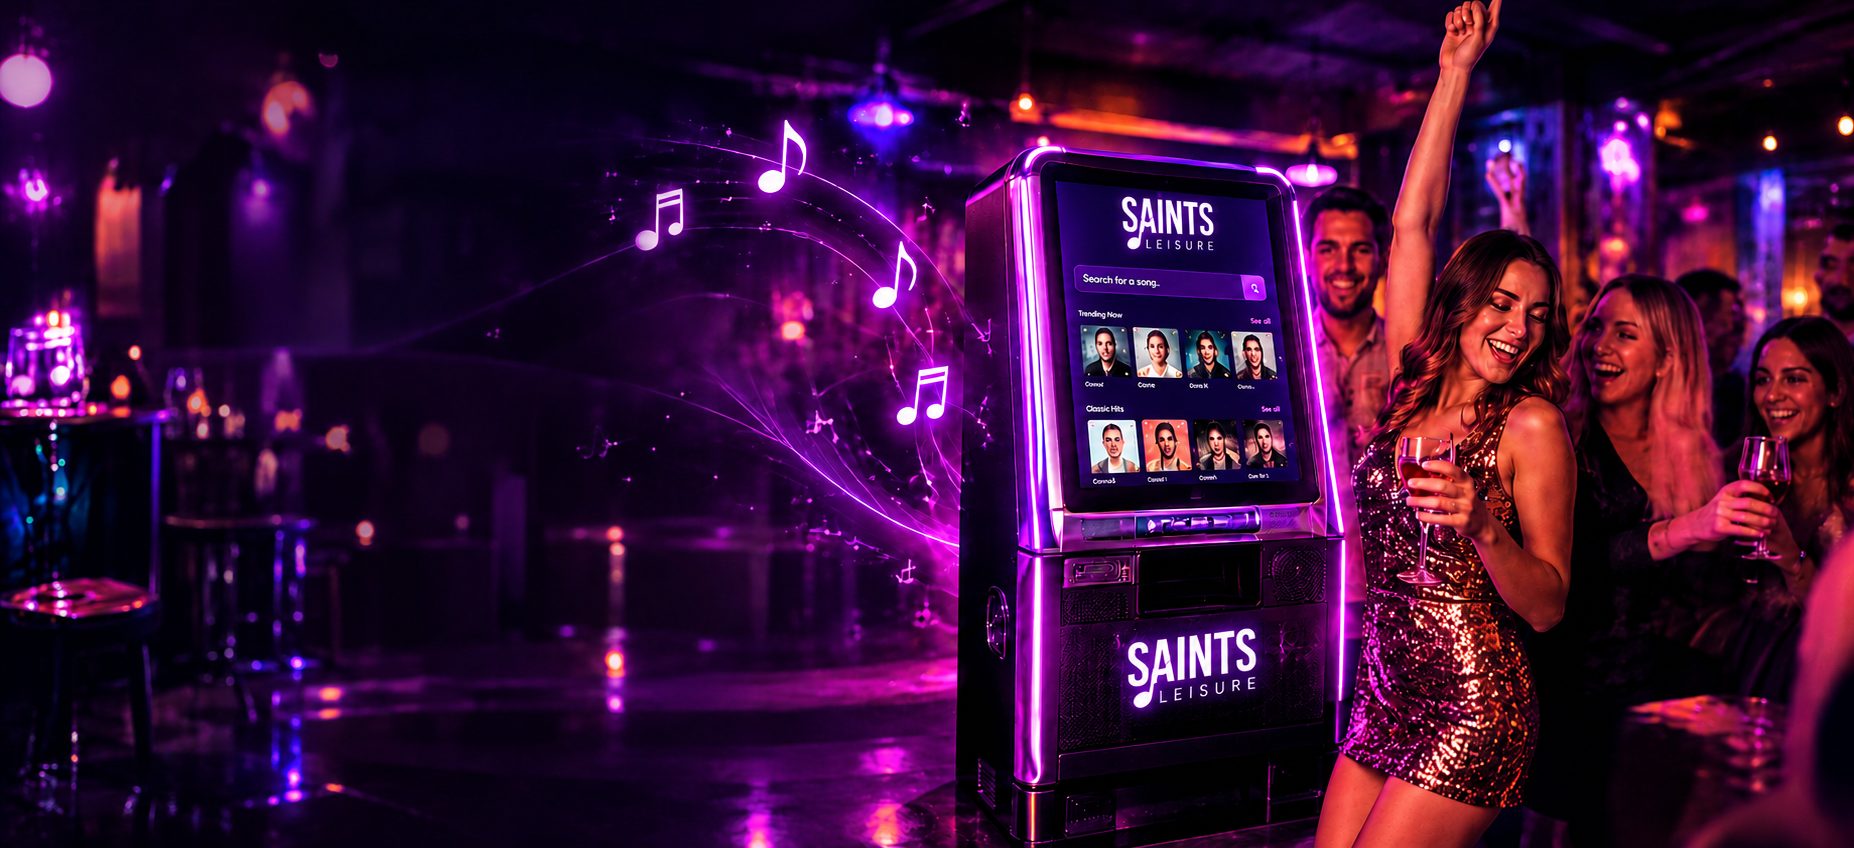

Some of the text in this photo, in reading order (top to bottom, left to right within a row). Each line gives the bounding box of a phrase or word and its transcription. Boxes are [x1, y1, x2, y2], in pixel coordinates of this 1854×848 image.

[1121, 196, 1215, 249] SAINTS
[1145, 239, 1214, 251] LEISURE
[1082, 273, 1113, 284] Search
[1115, 275, 1127, 285] for
[1128, 278, 1135, 286] a
[1078, 310, 1123, 320] Trending Now
[1086, 405, 1125, 413] Classic Hits
[1127, 627, 1257, 708] SAINTS
[1159, 676, 1257, 704] LEISURE
